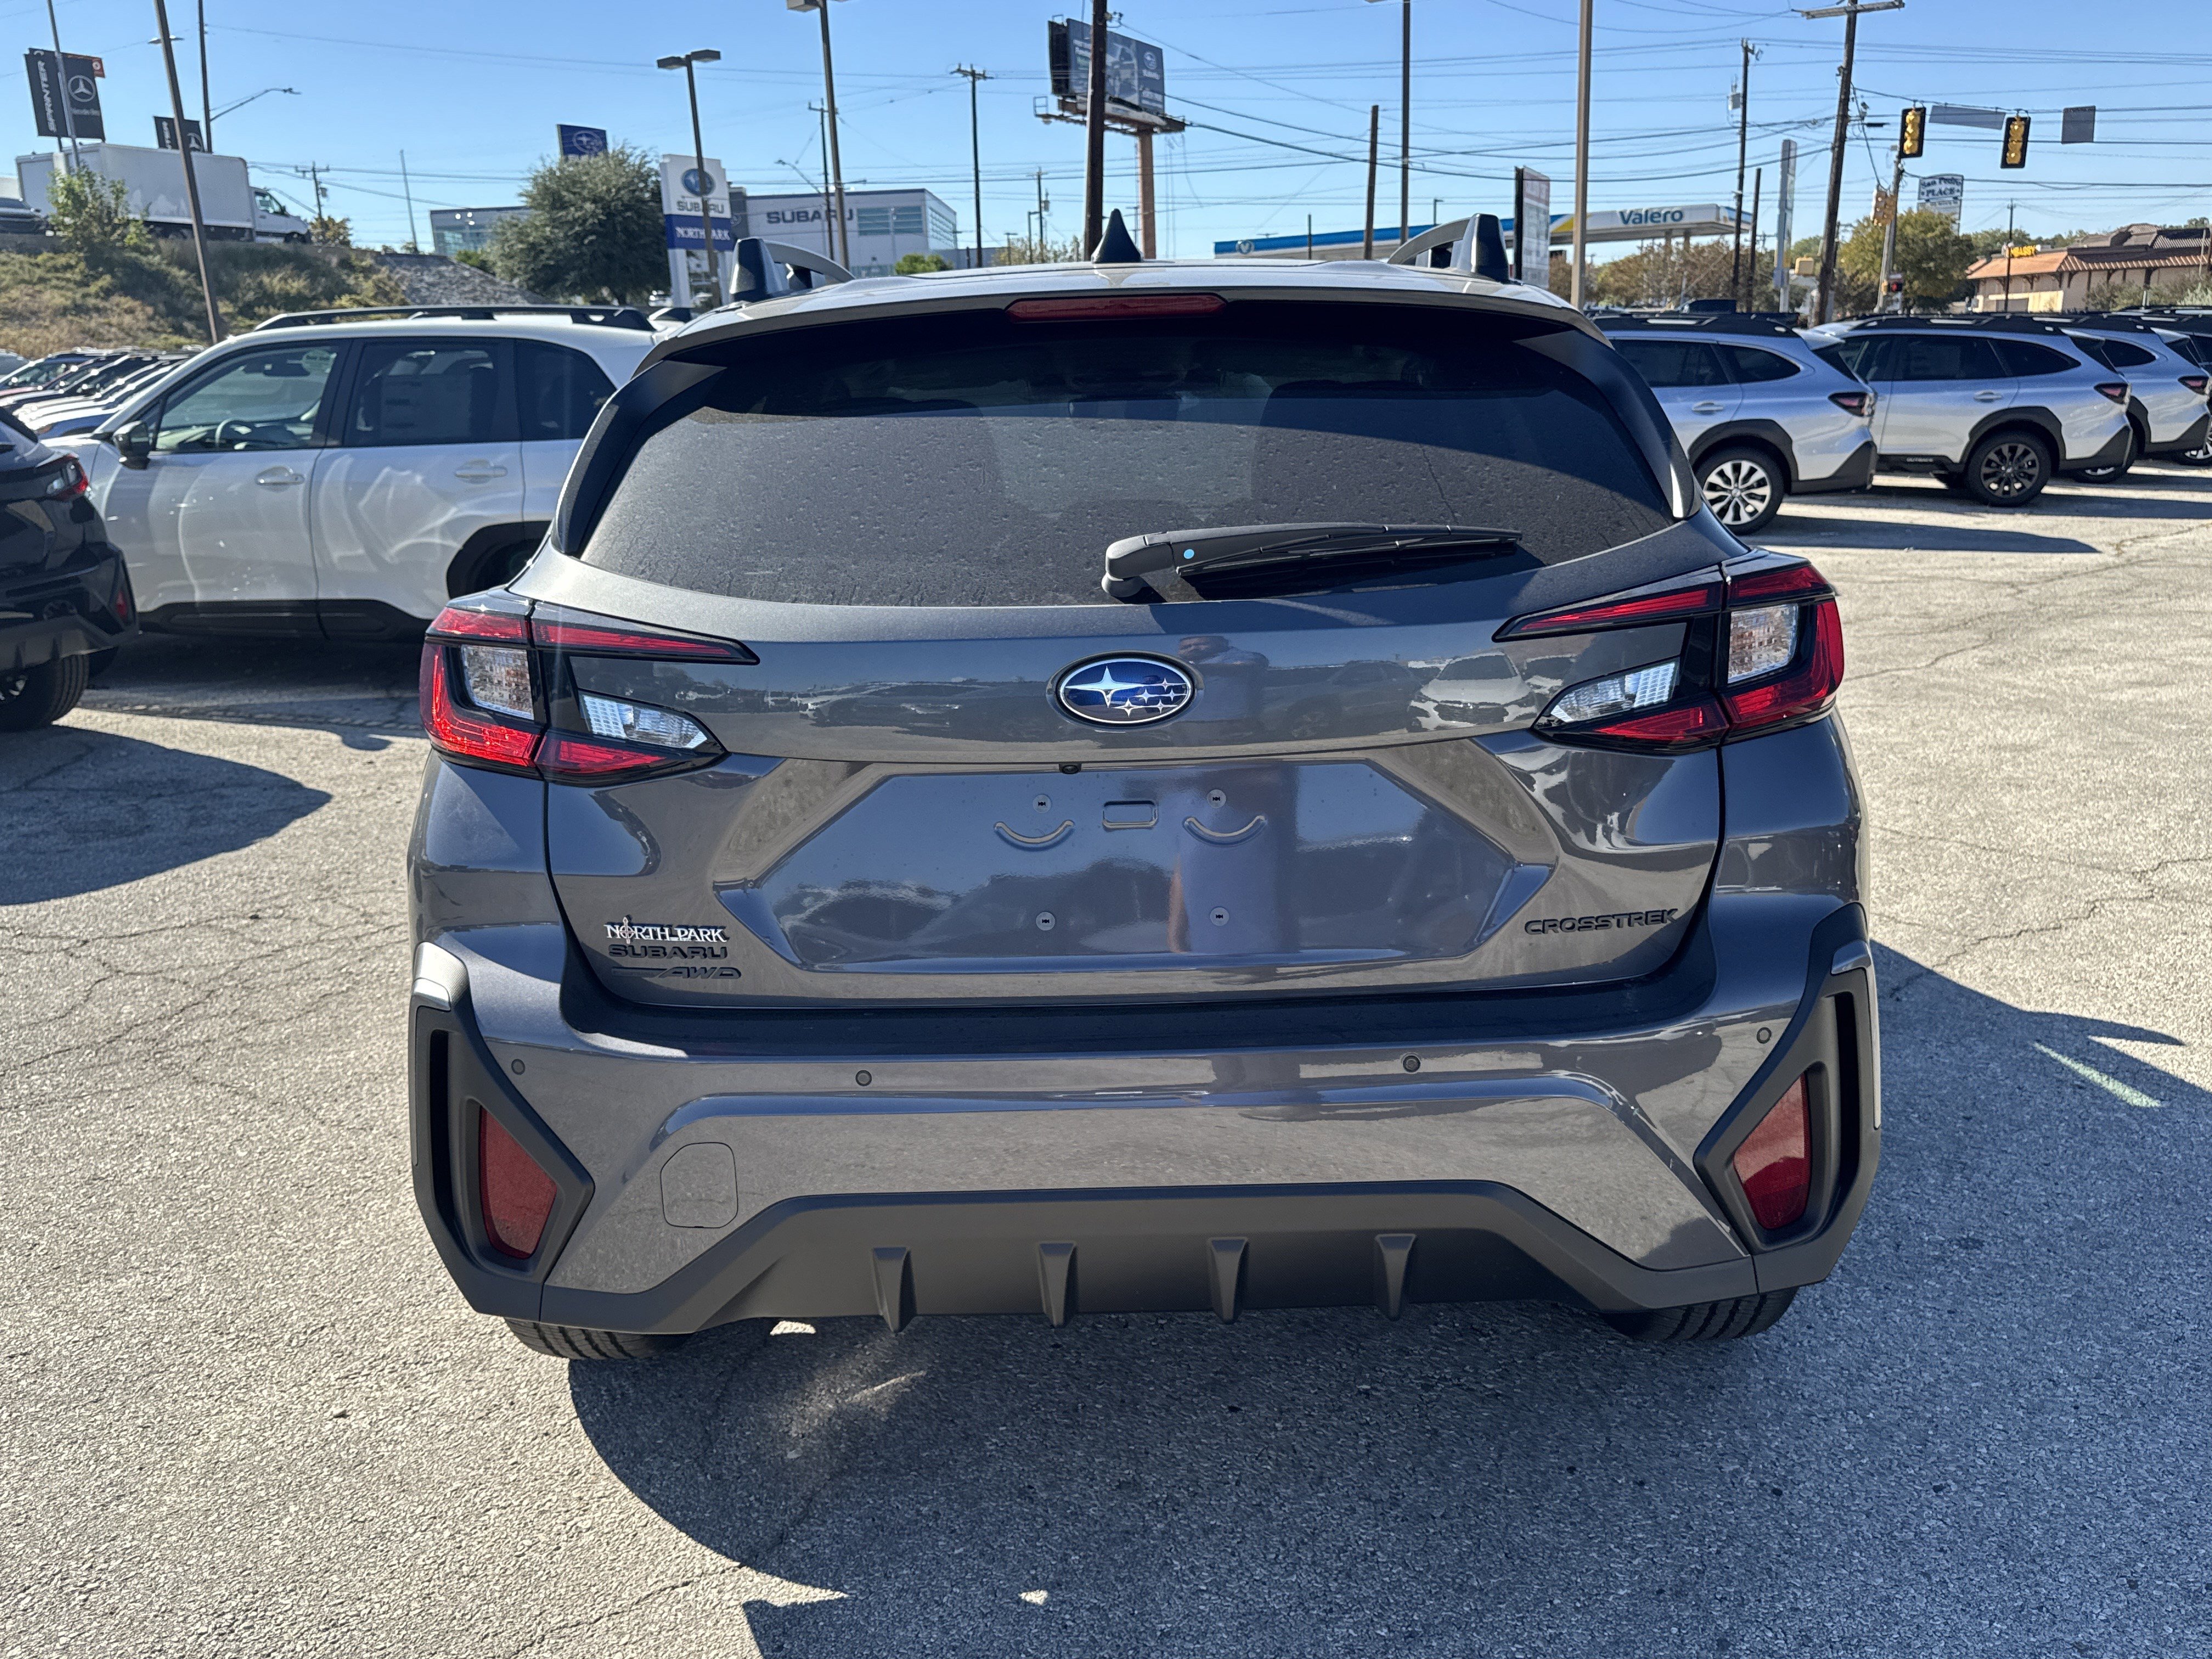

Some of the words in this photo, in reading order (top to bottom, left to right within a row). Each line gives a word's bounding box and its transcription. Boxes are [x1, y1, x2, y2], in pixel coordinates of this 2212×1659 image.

[676, 200, 724, 213] SUBRU
[1619, 209, 1683, 224] Valero
[710, 228, 730, 240] ARK
[1525, 908, 1678, 935] CROSSTREK
[604, 922, 670, 943] NORTH
[674, 927, 727, 943] PARK
[608, 944, 728, 959] SUBARU
[658, 967, 742, 979] AWD
